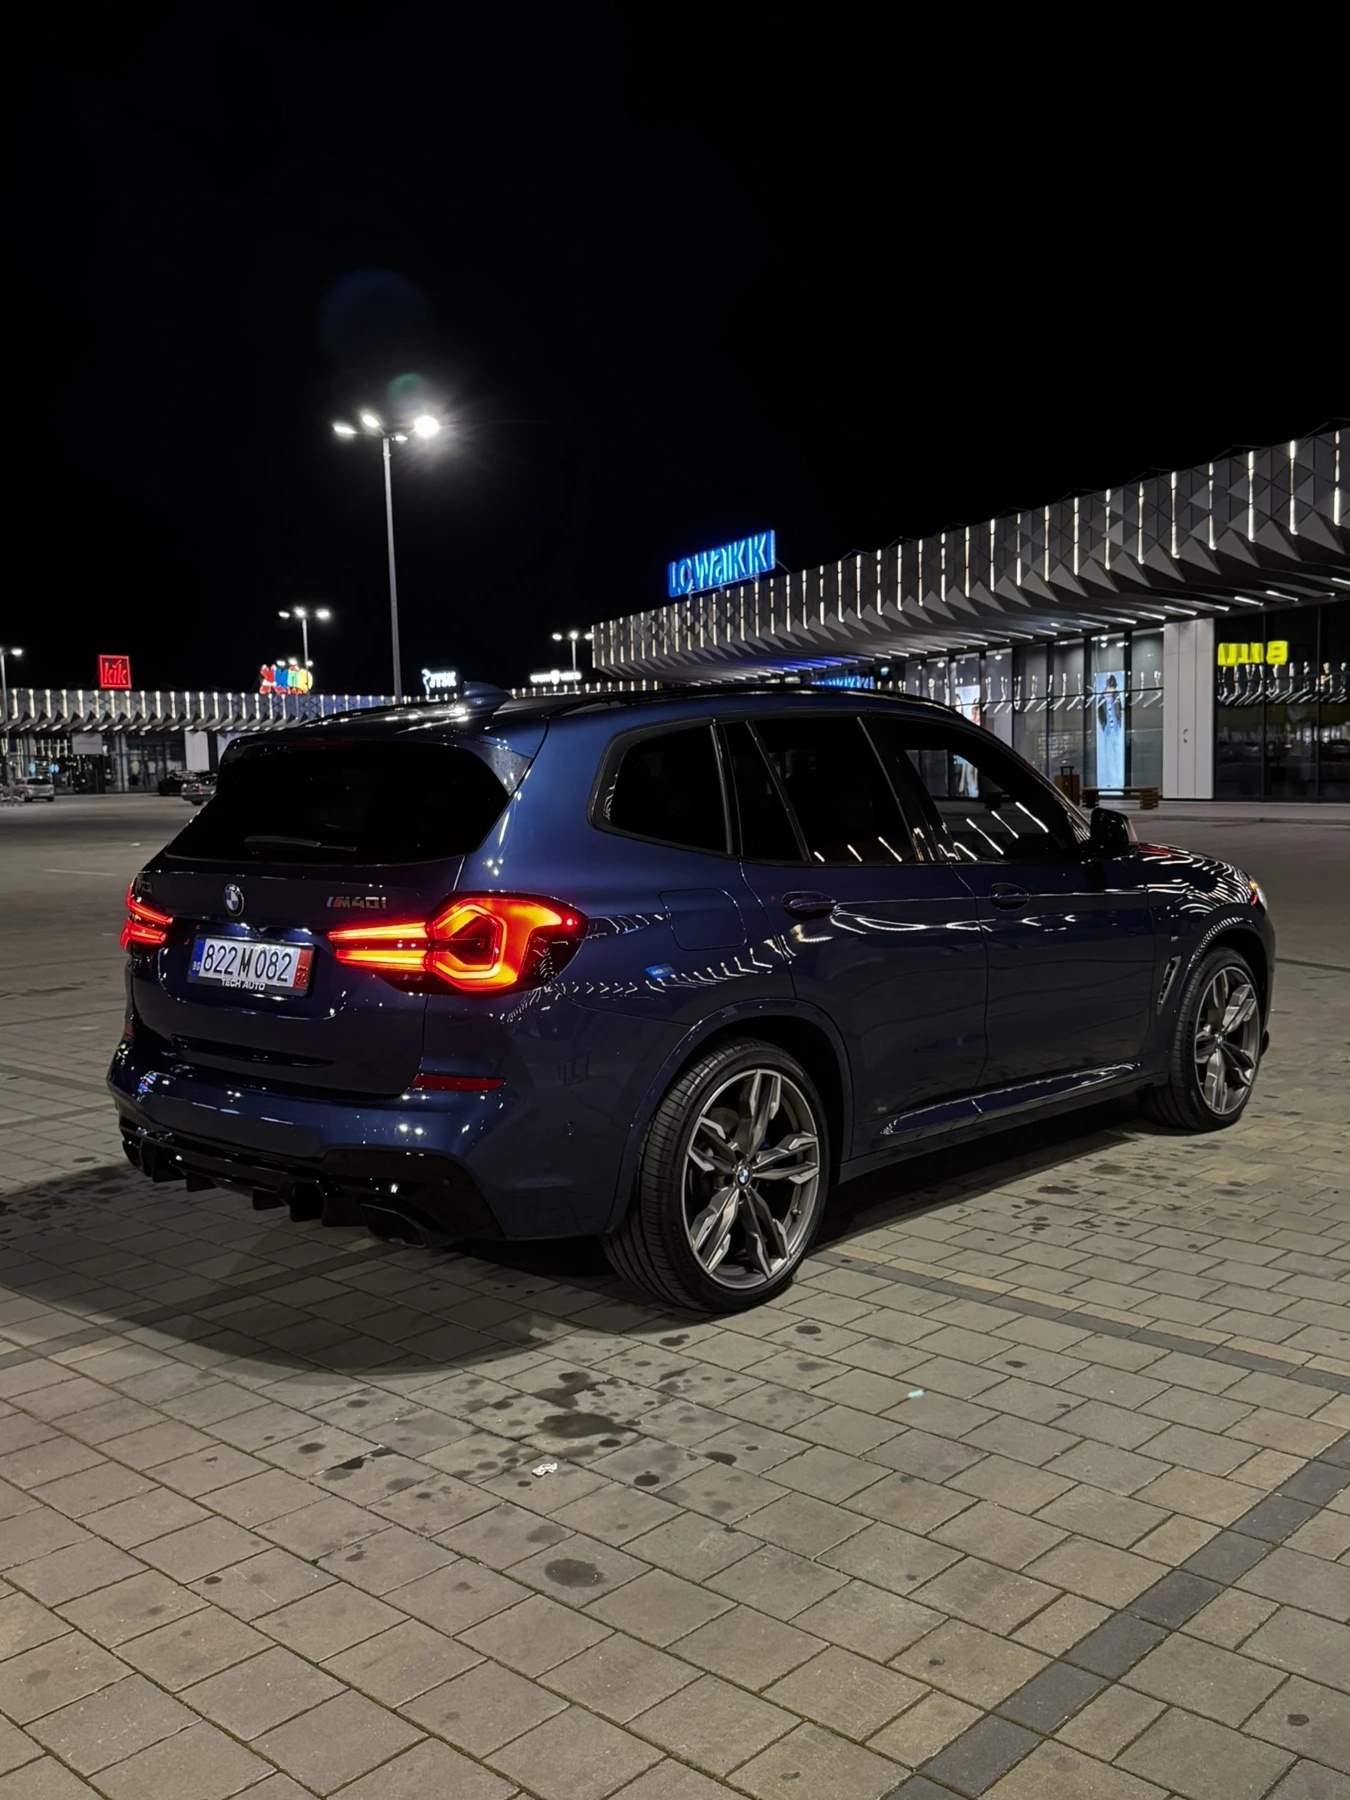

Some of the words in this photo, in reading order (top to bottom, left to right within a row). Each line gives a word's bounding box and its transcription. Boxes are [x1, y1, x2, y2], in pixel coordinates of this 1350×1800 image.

[203, 944, 237, 975] 822
[238, 947, 253, 977] M
[255, 949, 292, 982] 082
[221, 978, 241, 989] TECH
[243, 981, 266, 991] AUTO
